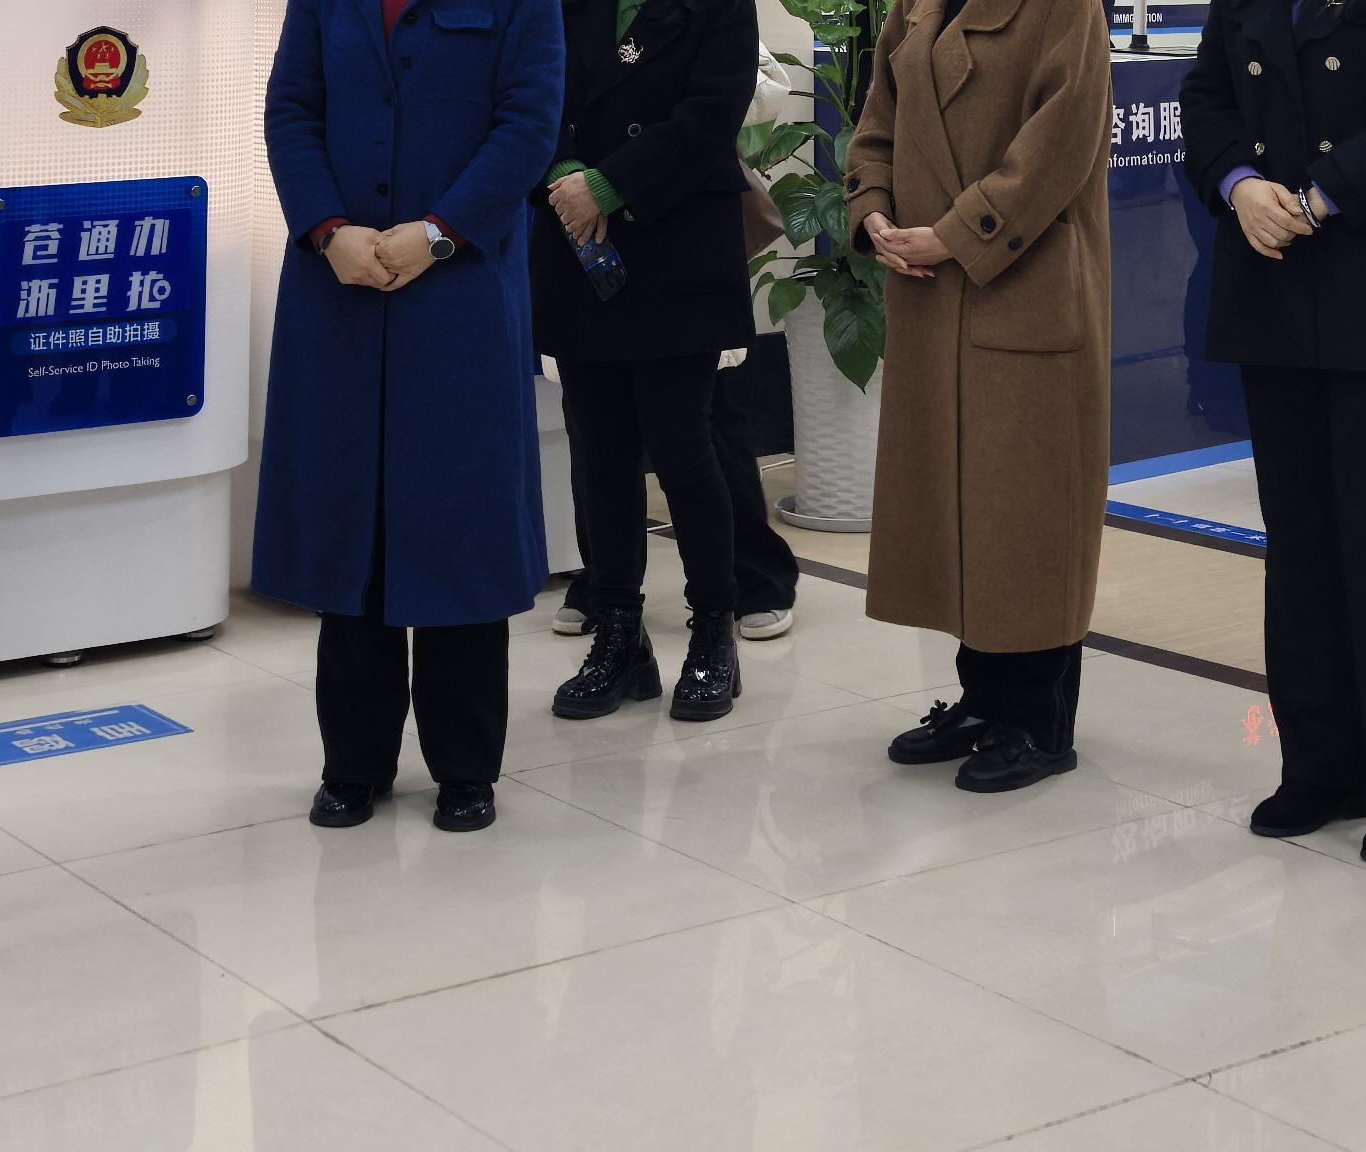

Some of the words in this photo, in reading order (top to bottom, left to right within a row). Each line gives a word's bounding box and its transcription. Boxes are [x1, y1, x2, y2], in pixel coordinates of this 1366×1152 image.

[21, 216, 170, 266] 苍通办
[29, 321, 161, 352] 证件照自助拍摄
[28, 363, 84, 378] Self-Service
[86, 361, 99, 373] ID
[101, 358, 130, 371] Photo
[131, 356, 161, 368] Taking
